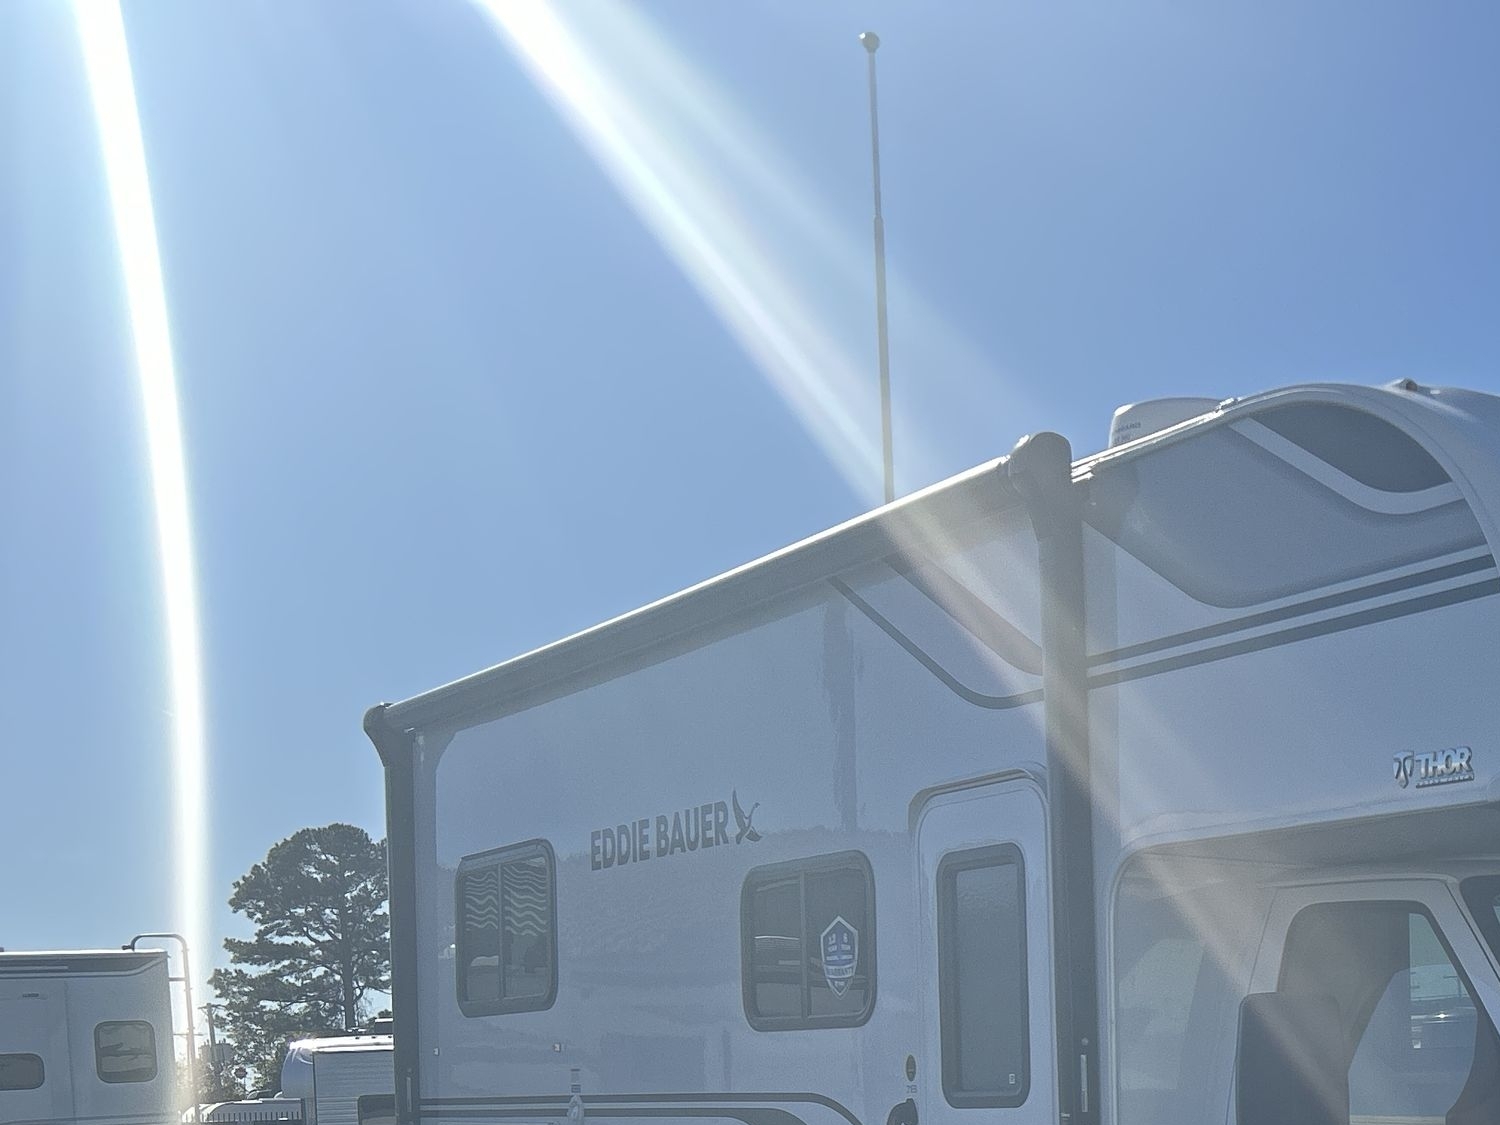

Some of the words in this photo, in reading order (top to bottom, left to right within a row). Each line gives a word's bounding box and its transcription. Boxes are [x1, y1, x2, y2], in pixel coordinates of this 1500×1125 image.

[1415, 746, 1472, 780] THOR
[591, 818, 651, 872] EDDIE
[656, 800, 730, 858] BAUER
